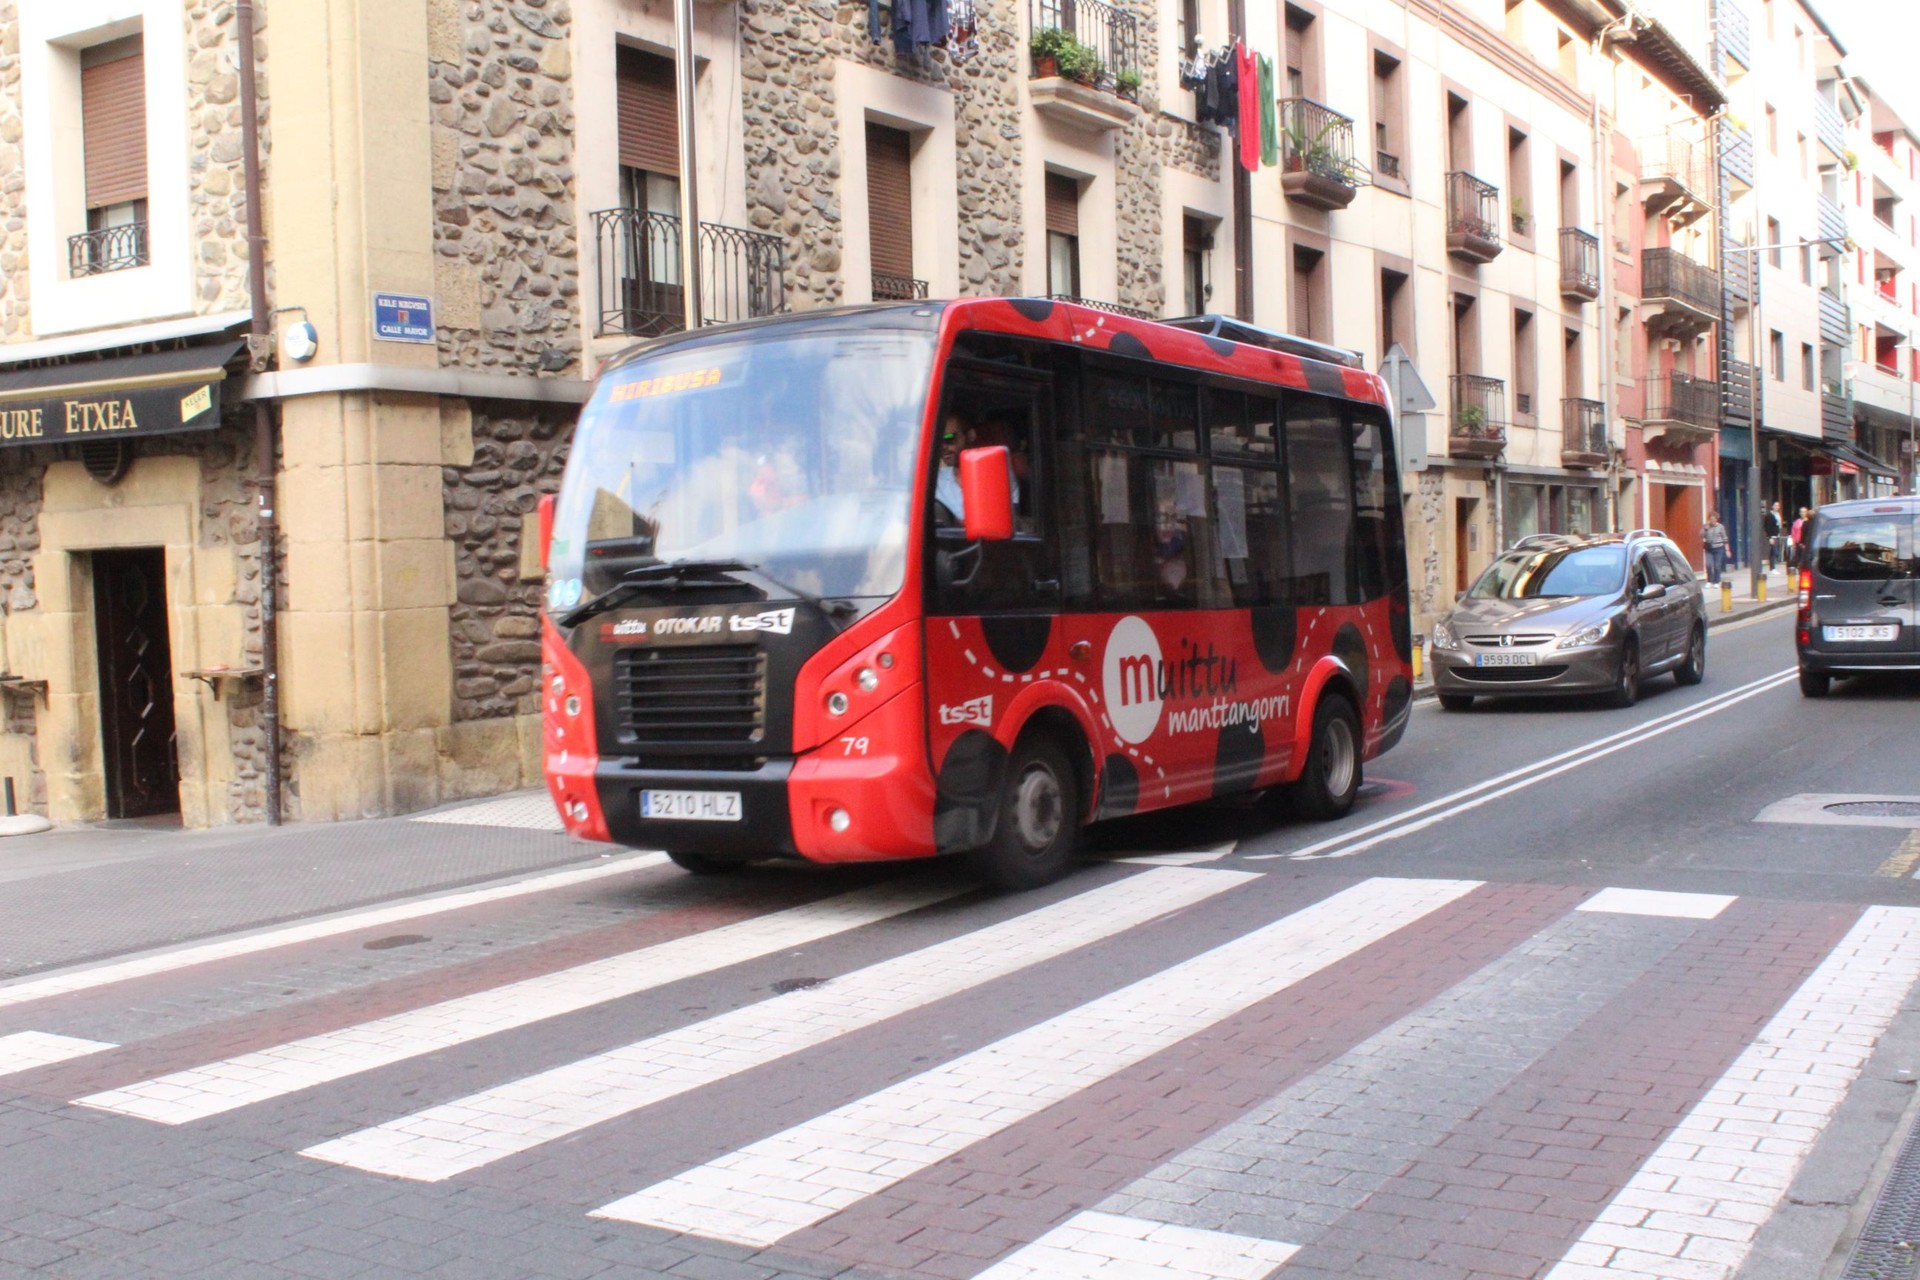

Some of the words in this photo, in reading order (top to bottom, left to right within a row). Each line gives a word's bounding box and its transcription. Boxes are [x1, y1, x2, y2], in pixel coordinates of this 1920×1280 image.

[381, 325, 402, 334] CALLE
[404, 326, 428, 336] MAYOR
[0, 408, 44, 439] URE
[64, 399, 138, 434] ETXEA
[653, 615, 723, 635] OTOKAR
[728, 609, 792, 633] tsst
[1836, 627, 1864, 638] 5102
[1483, 654, 1510, 665] 9593
[1512, 654, 1533, 665] DCL
[1119, 638, 1237, 707] muittu
[938, 698, 991, 726] tsst
[1168, 684, 1291, 737] manttangorri
[840, 736, 870, 756] 79
[652, 794, 696, 815] 5210
[701, 795, 736, 816] HLZ
